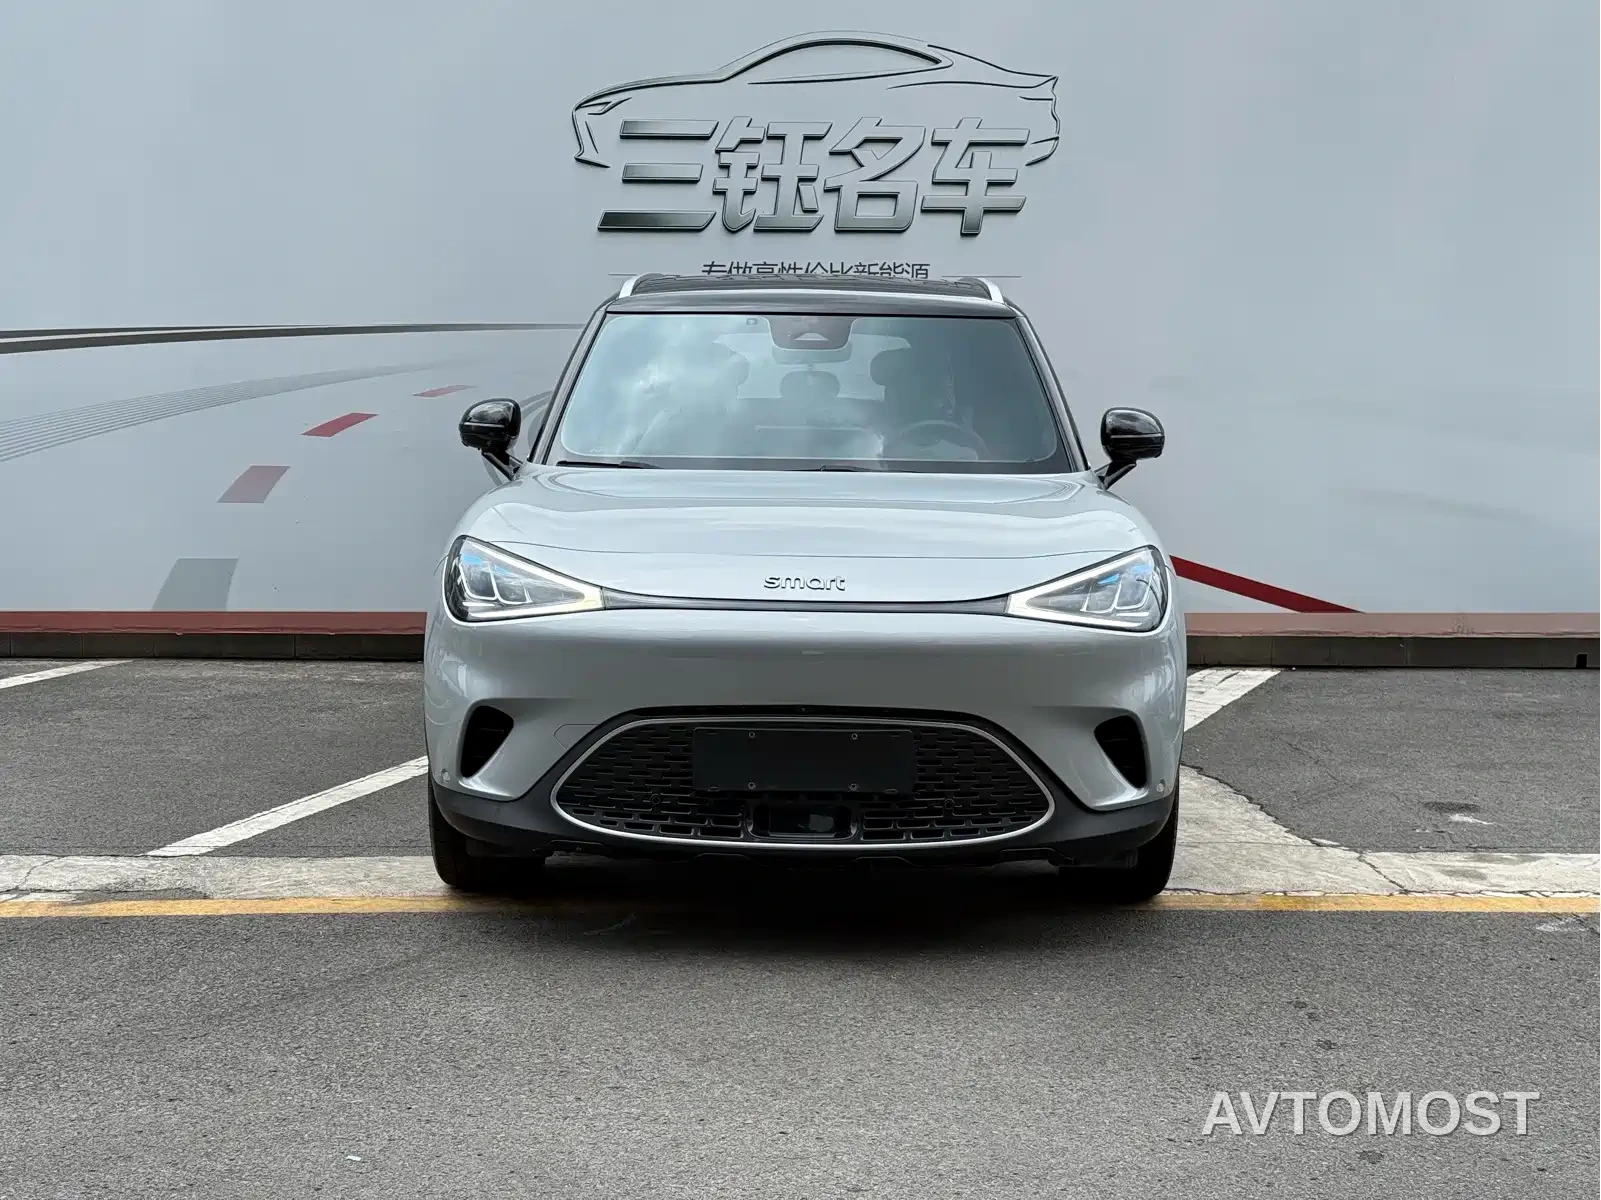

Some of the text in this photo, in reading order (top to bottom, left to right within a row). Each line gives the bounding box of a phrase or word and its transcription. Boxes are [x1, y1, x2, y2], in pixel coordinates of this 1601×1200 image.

[598, 116, 1031, 235] 三钰名车
[763, 575, 847, 591] smart
